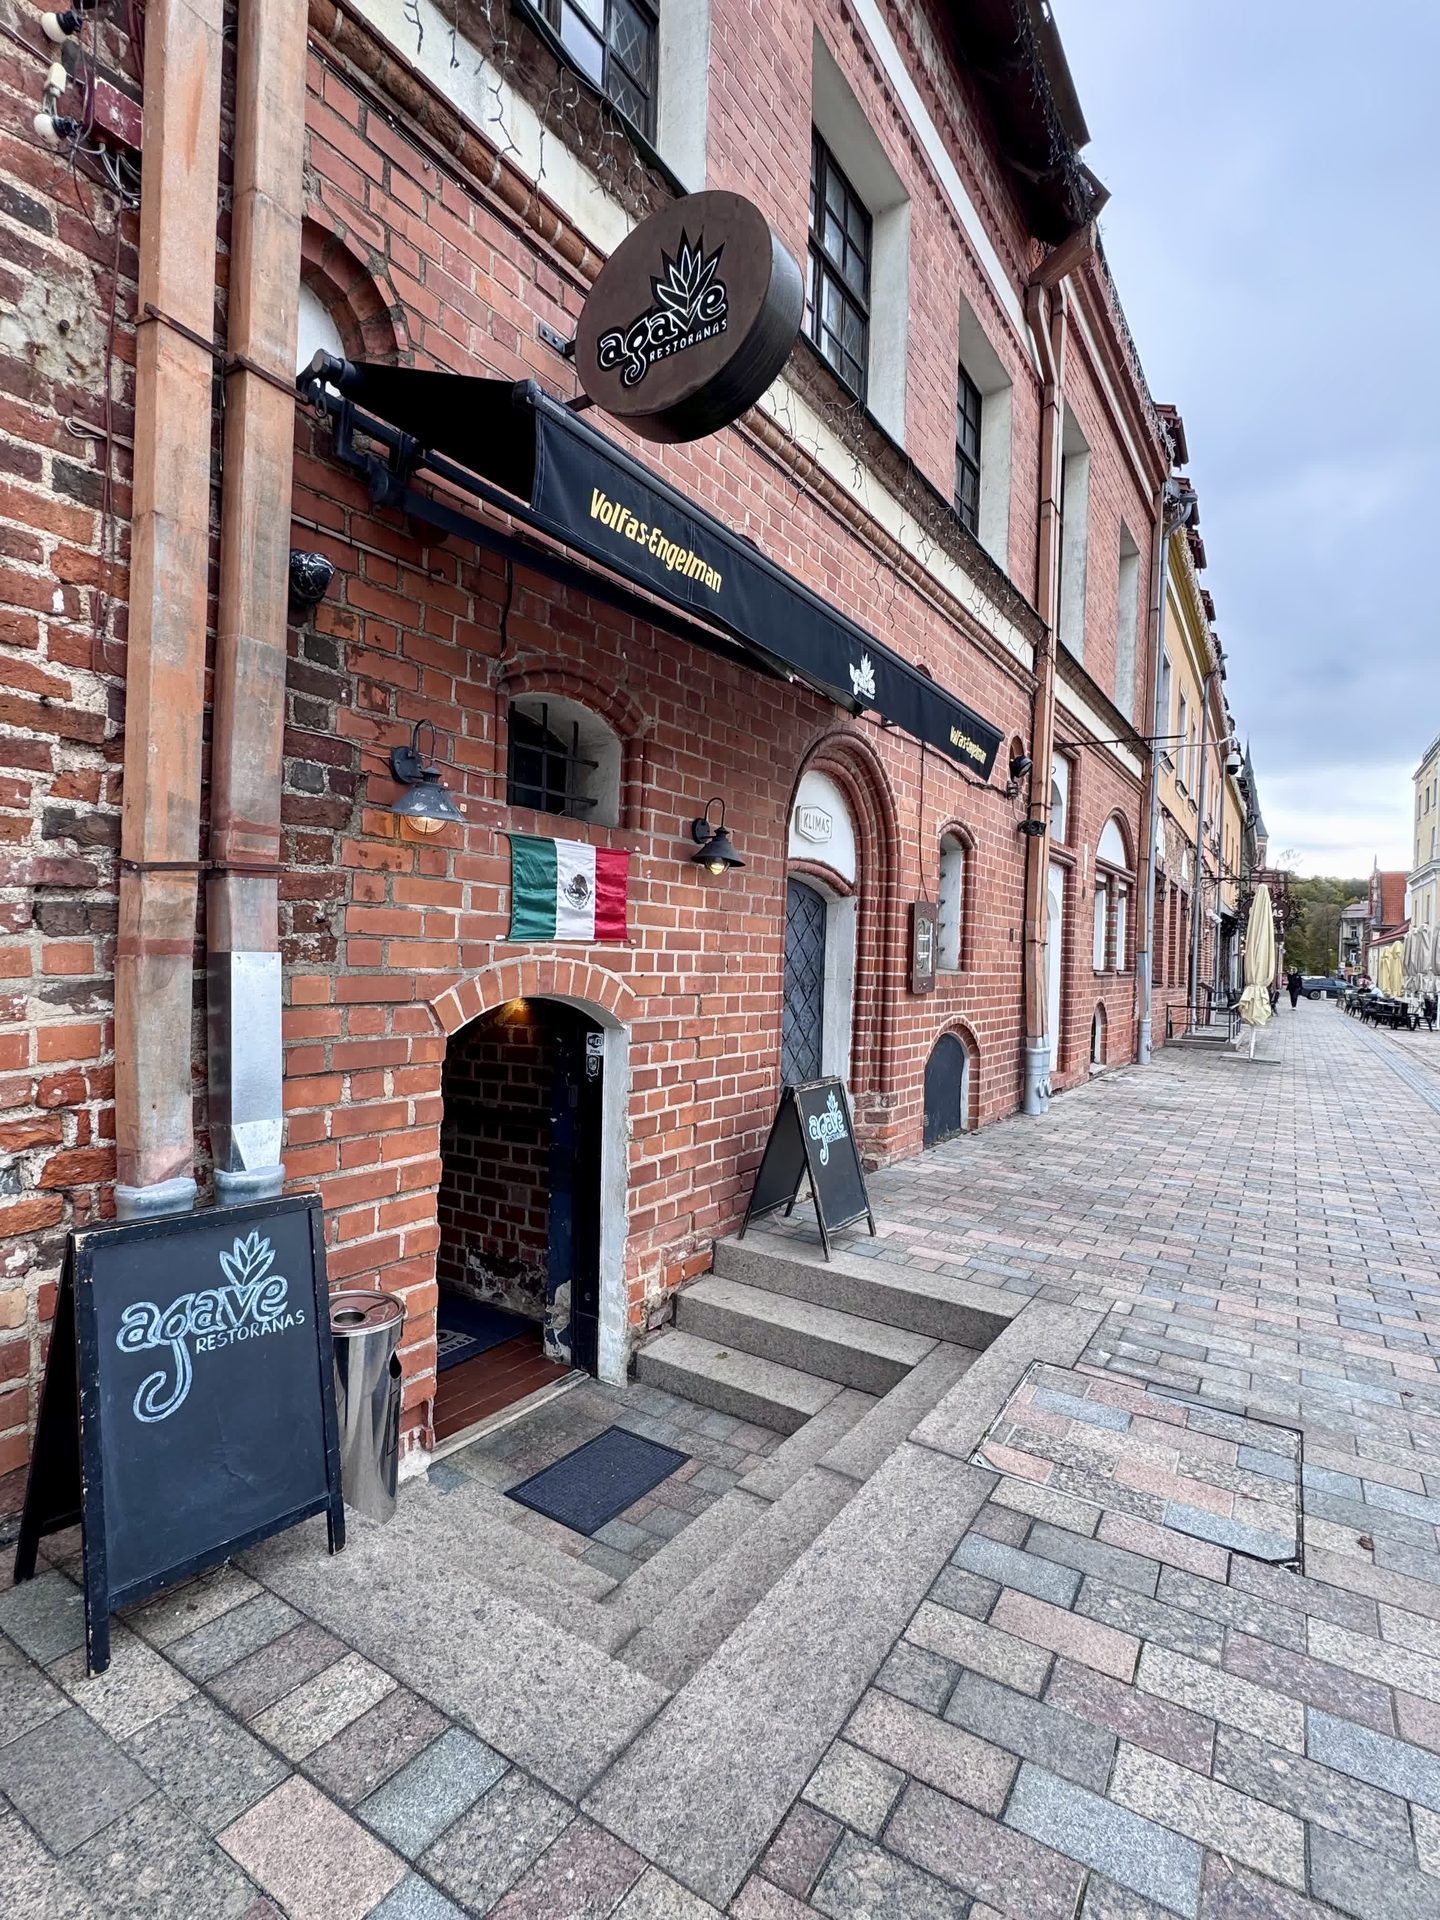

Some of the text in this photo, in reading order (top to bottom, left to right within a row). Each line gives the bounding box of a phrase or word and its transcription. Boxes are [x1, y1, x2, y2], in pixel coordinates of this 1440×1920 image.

[600, 284, 727, 386] agave
[649, 318, 728, 363] RESTORANAS
[803, 811, 830, 834] KLIMAS
[116, 1274, 289, 1424] agave
[195, 1308, 306, 1355] RESTORANAS
